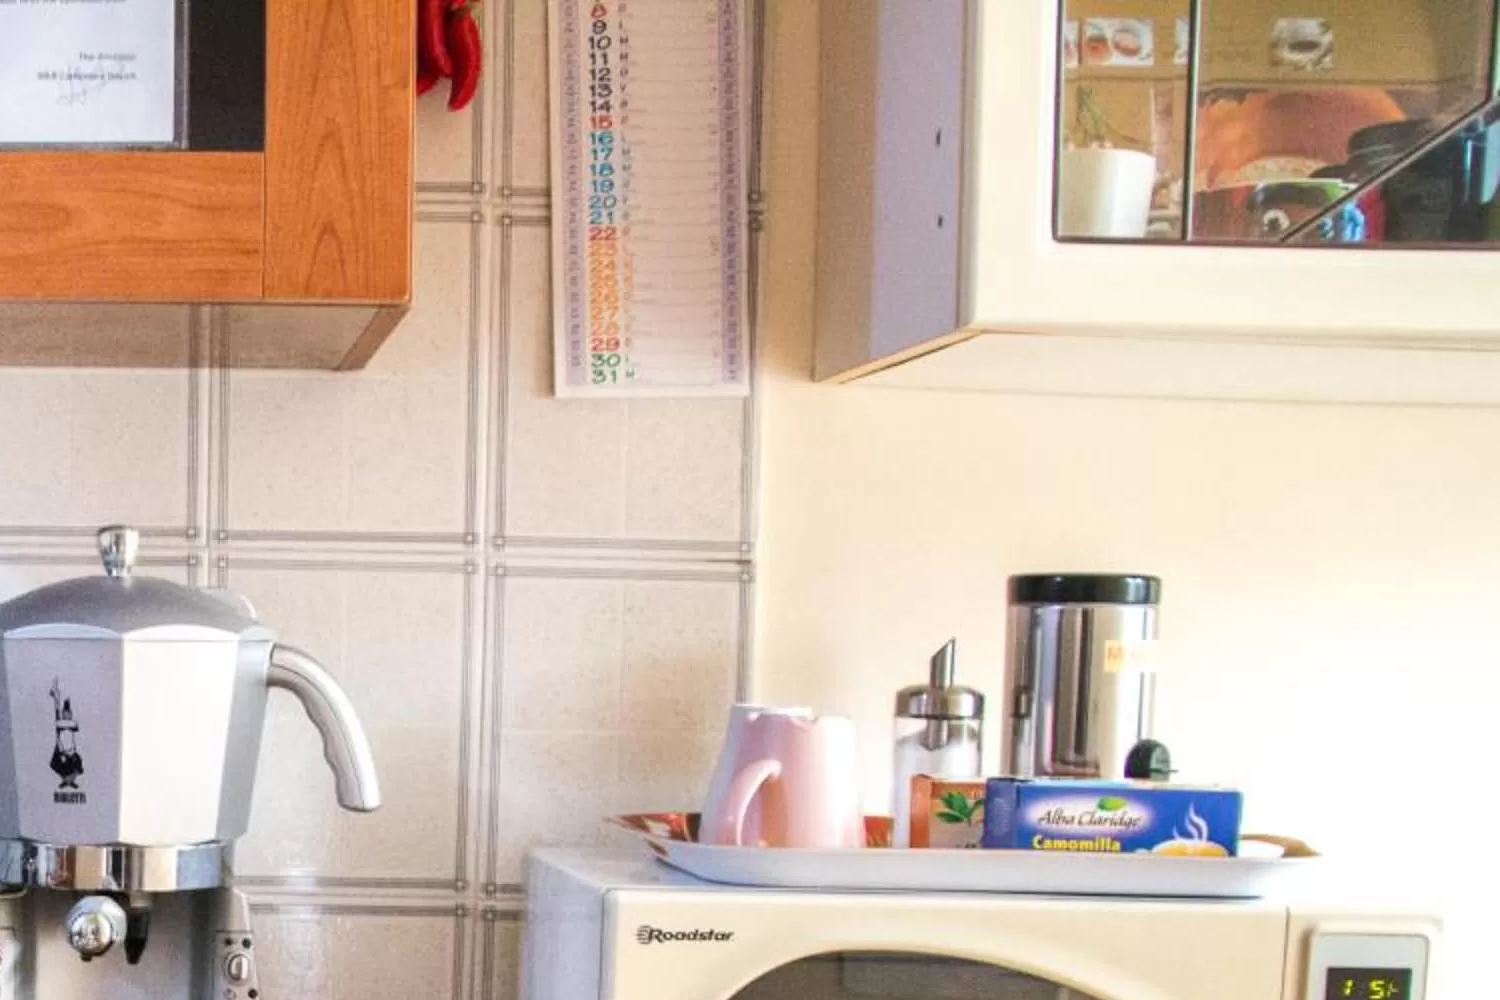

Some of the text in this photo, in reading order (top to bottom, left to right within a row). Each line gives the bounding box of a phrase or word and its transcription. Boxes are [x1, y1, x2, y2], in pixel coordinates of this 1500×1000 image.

[588, 36, 612, 49] 10
[589, 52, 610, 65] 11
[589, 68, 611, 82] 12
[589, 84, 613, 98] 13
[590, 100, 612, 112] 14
[590, 115, 613, 129] 15
[590, 132, 613, 145] 16
[591, 148, 613, 160] 17
[589, 195, 617, 209] 20
[589, 211, 613, 225] 21
[588, 226, 617, 241] 22
[591, 337, 620, 352] 29
[591, 353, 621, 368] 30
[591, 369, 618, 384] 31
[1038, 809, 1142, 829] Alba Claridge
[1032, 835, 1121, 853] Camomilla
[638, 926, 735, 943] Roadstar
